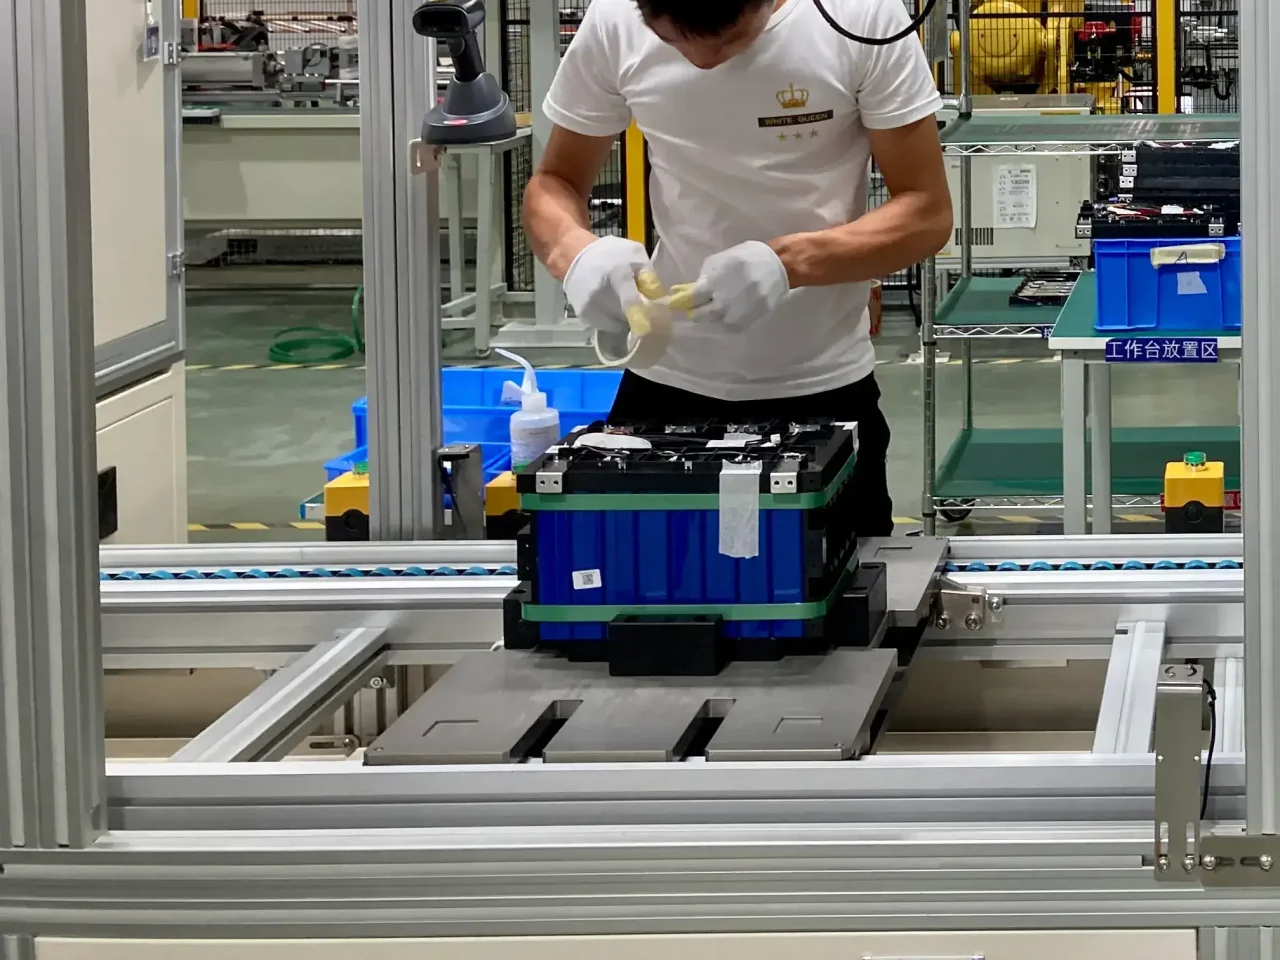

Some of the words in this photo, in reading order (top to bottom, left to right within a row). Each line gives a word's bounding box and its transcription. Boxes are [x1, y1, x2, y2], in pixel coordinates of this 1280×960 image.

[765, 117, 793, 126] WHITE
[798, 112, 828, 122] QUEEN
[1106, 340, 1218, 359] 工作台放置区
